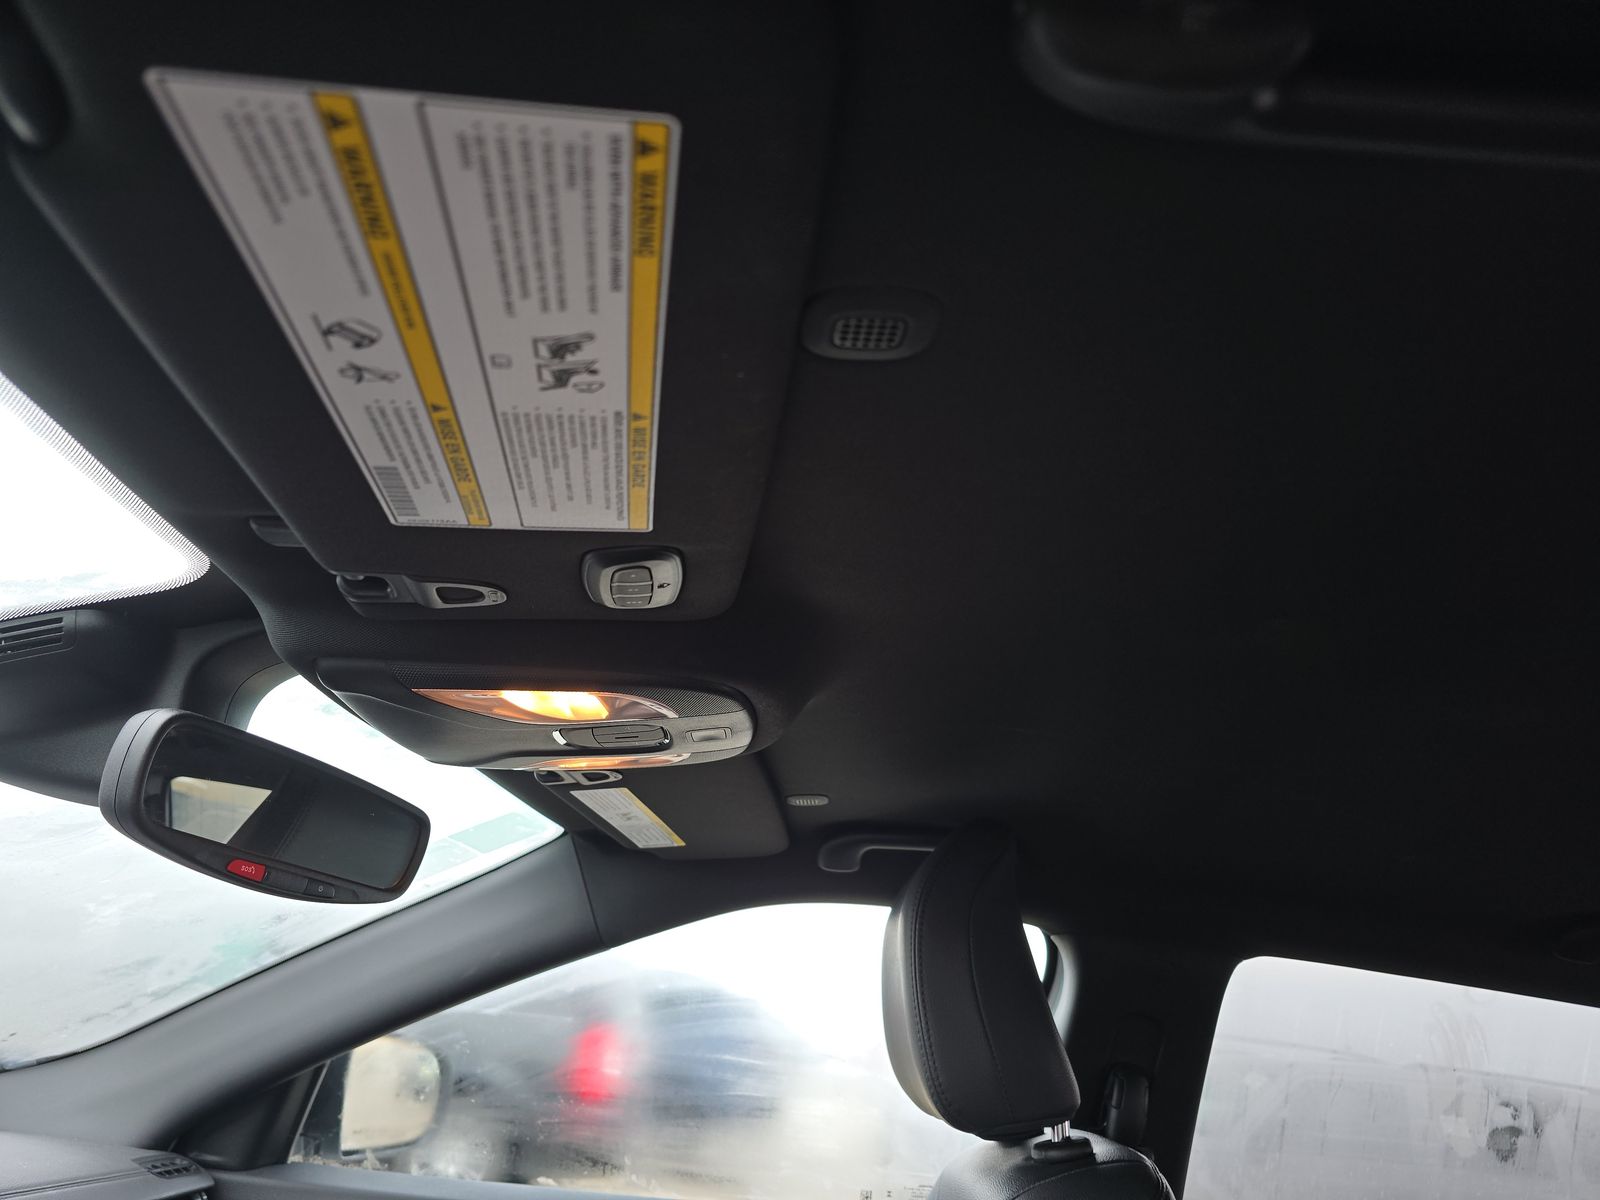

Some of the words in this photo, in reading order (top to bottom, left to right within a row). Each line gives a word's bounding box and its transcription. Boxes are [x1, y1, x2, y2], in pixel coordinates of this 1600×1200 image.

[342, 147, 389, 239] WARNING
[638, 170, 658, 257] WARNING
[437, 418, 457, 440] MISE
[633, 427, 646, 448] MISE
[444, 443, 462, 454] EN
[632, 450, 646, 461] EN
[450, 457, 472, 483] GARDE
[631, 463, 645, 488] GARDE
[241, 865, 252, 873] SOS
